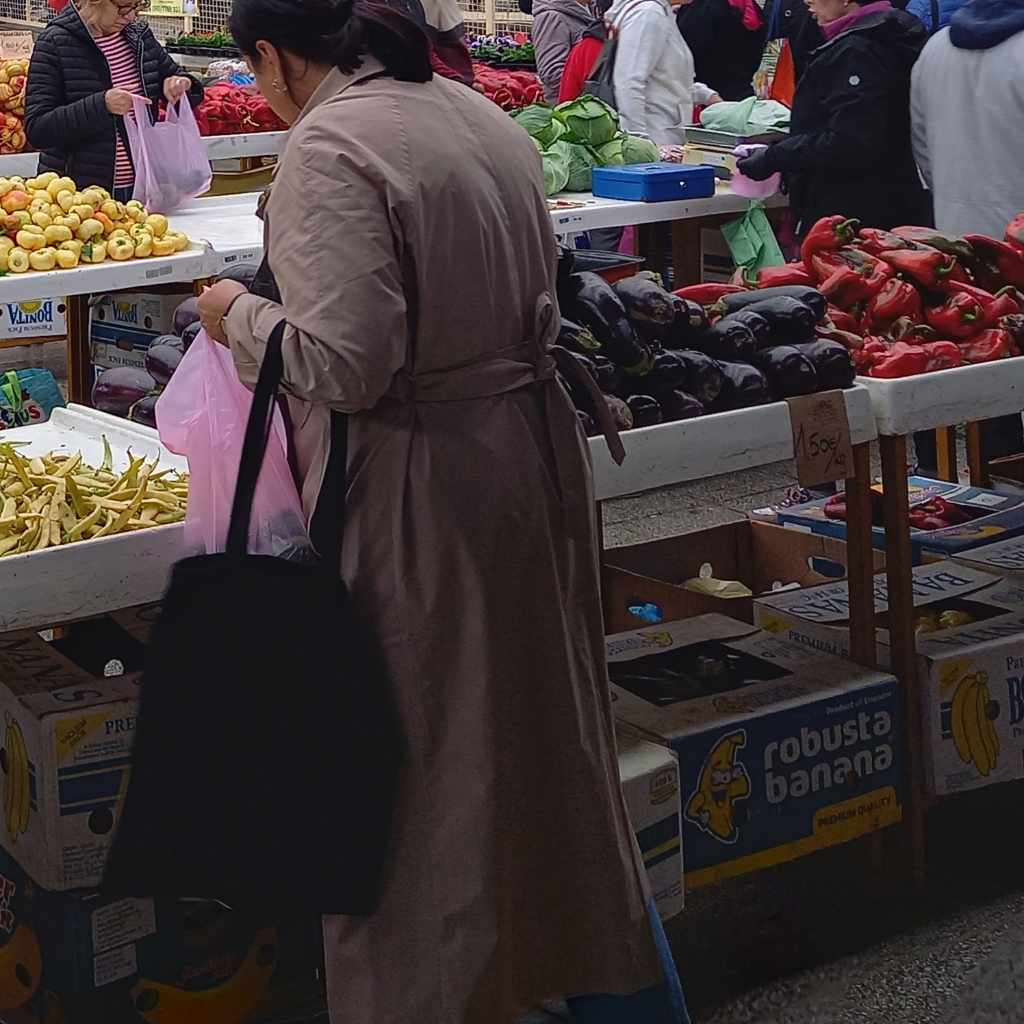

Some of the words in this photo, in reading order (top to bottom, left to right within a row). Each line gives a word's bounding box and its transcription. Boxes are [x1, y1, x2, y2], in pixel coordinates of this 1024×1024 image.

[7, 301, 53, 325] BONITA
[764, 709, 893, 771] robusta
[765, 742, 894, 805] banana
